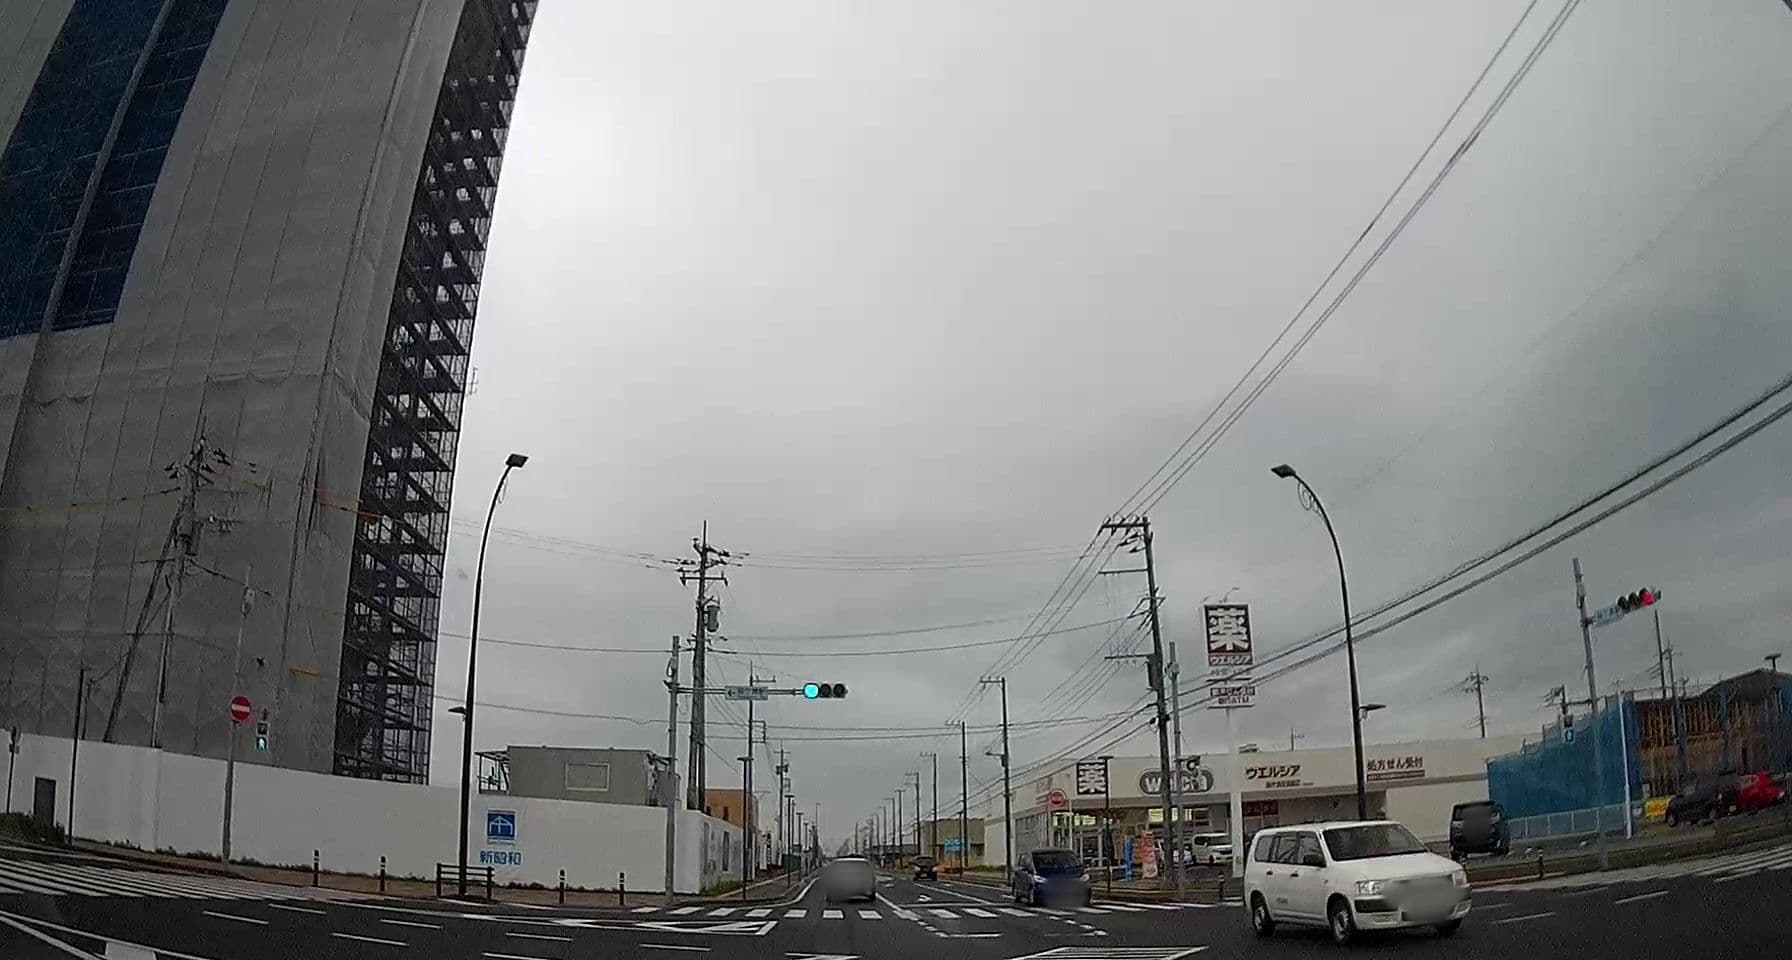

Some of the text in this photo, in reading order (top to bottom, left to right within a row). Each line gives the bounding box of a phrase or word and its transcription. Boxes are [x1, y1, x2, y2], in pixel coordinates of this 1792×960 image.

[1208, 607, 1248, 651] 薬
[1209, 655, 1250, 665] ウエルシア
[1079, 762, 1107, 792] 薬
[1246, 764, 1300, 779] ウエルシア
